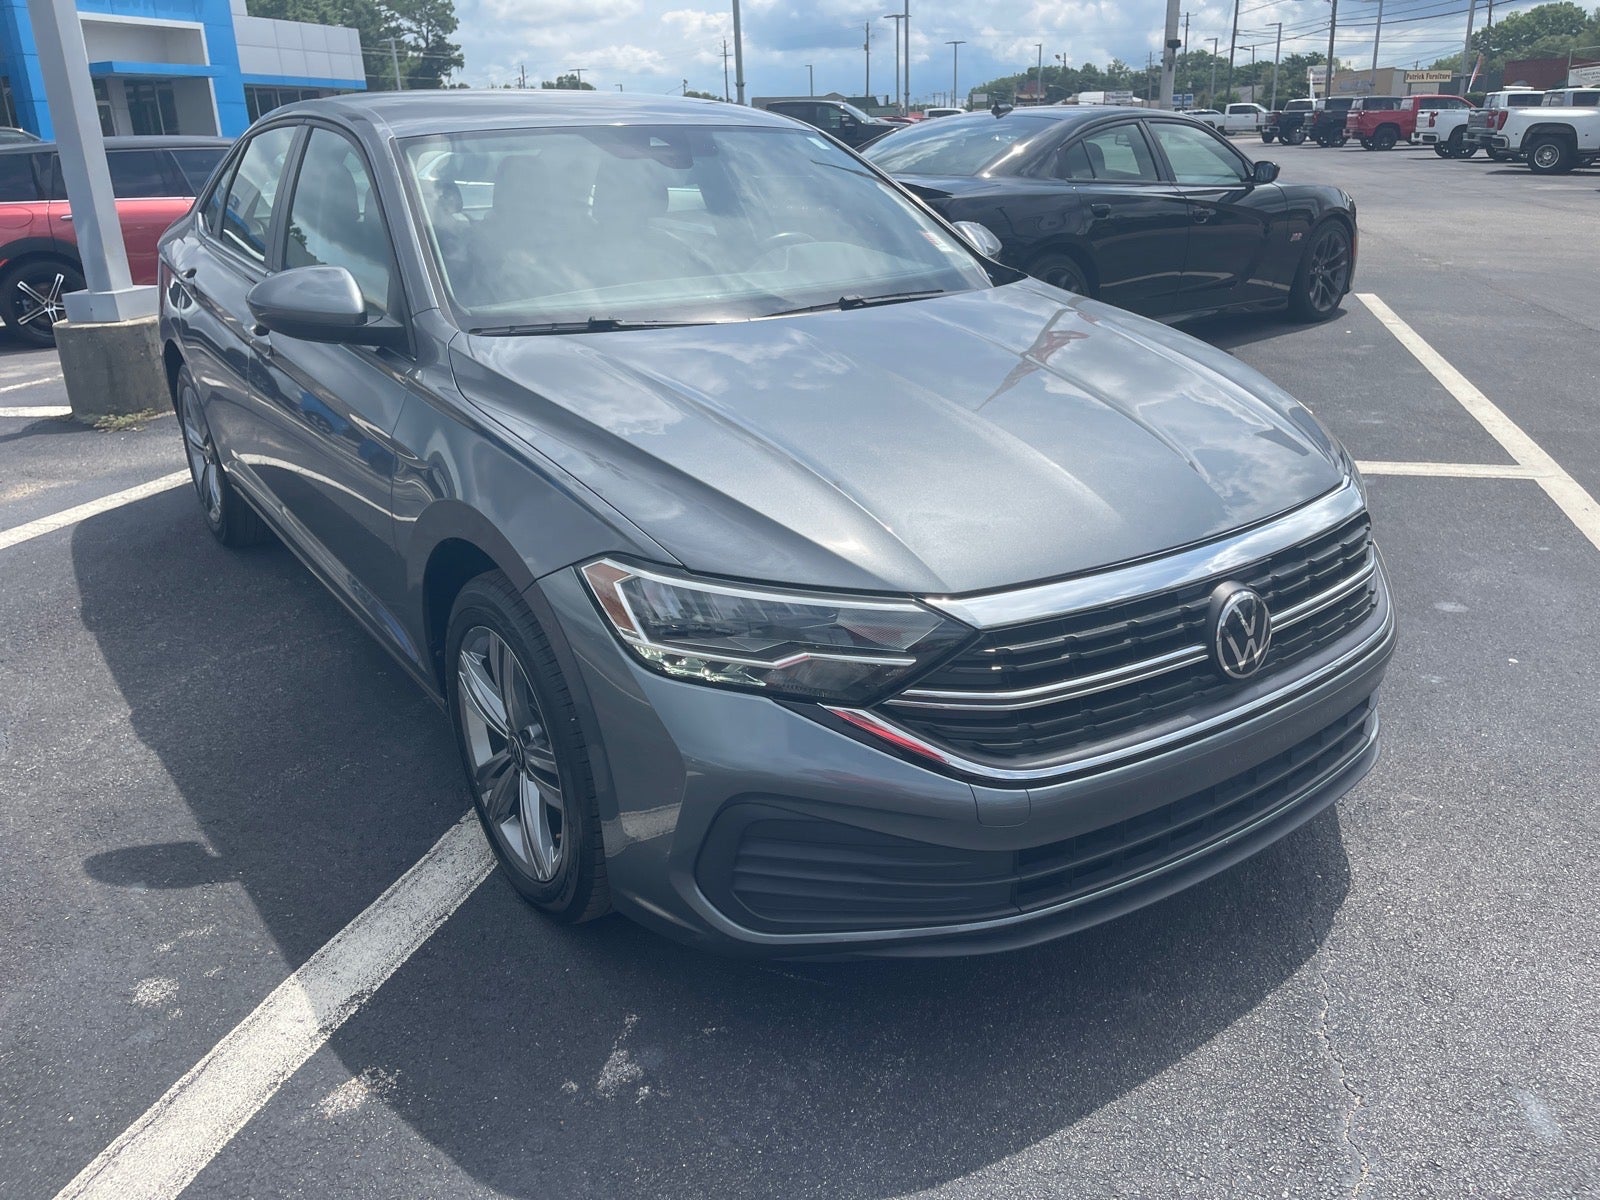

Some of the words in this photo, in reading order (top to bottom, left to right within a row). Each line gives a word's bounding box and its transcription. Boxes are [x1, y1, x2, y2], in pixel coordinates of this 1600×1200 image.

[1407, 72, 1424, 80] Patrick
[1426, 72, 1451, 80] Furniture
[1216, 590, 1270, 677] VW
